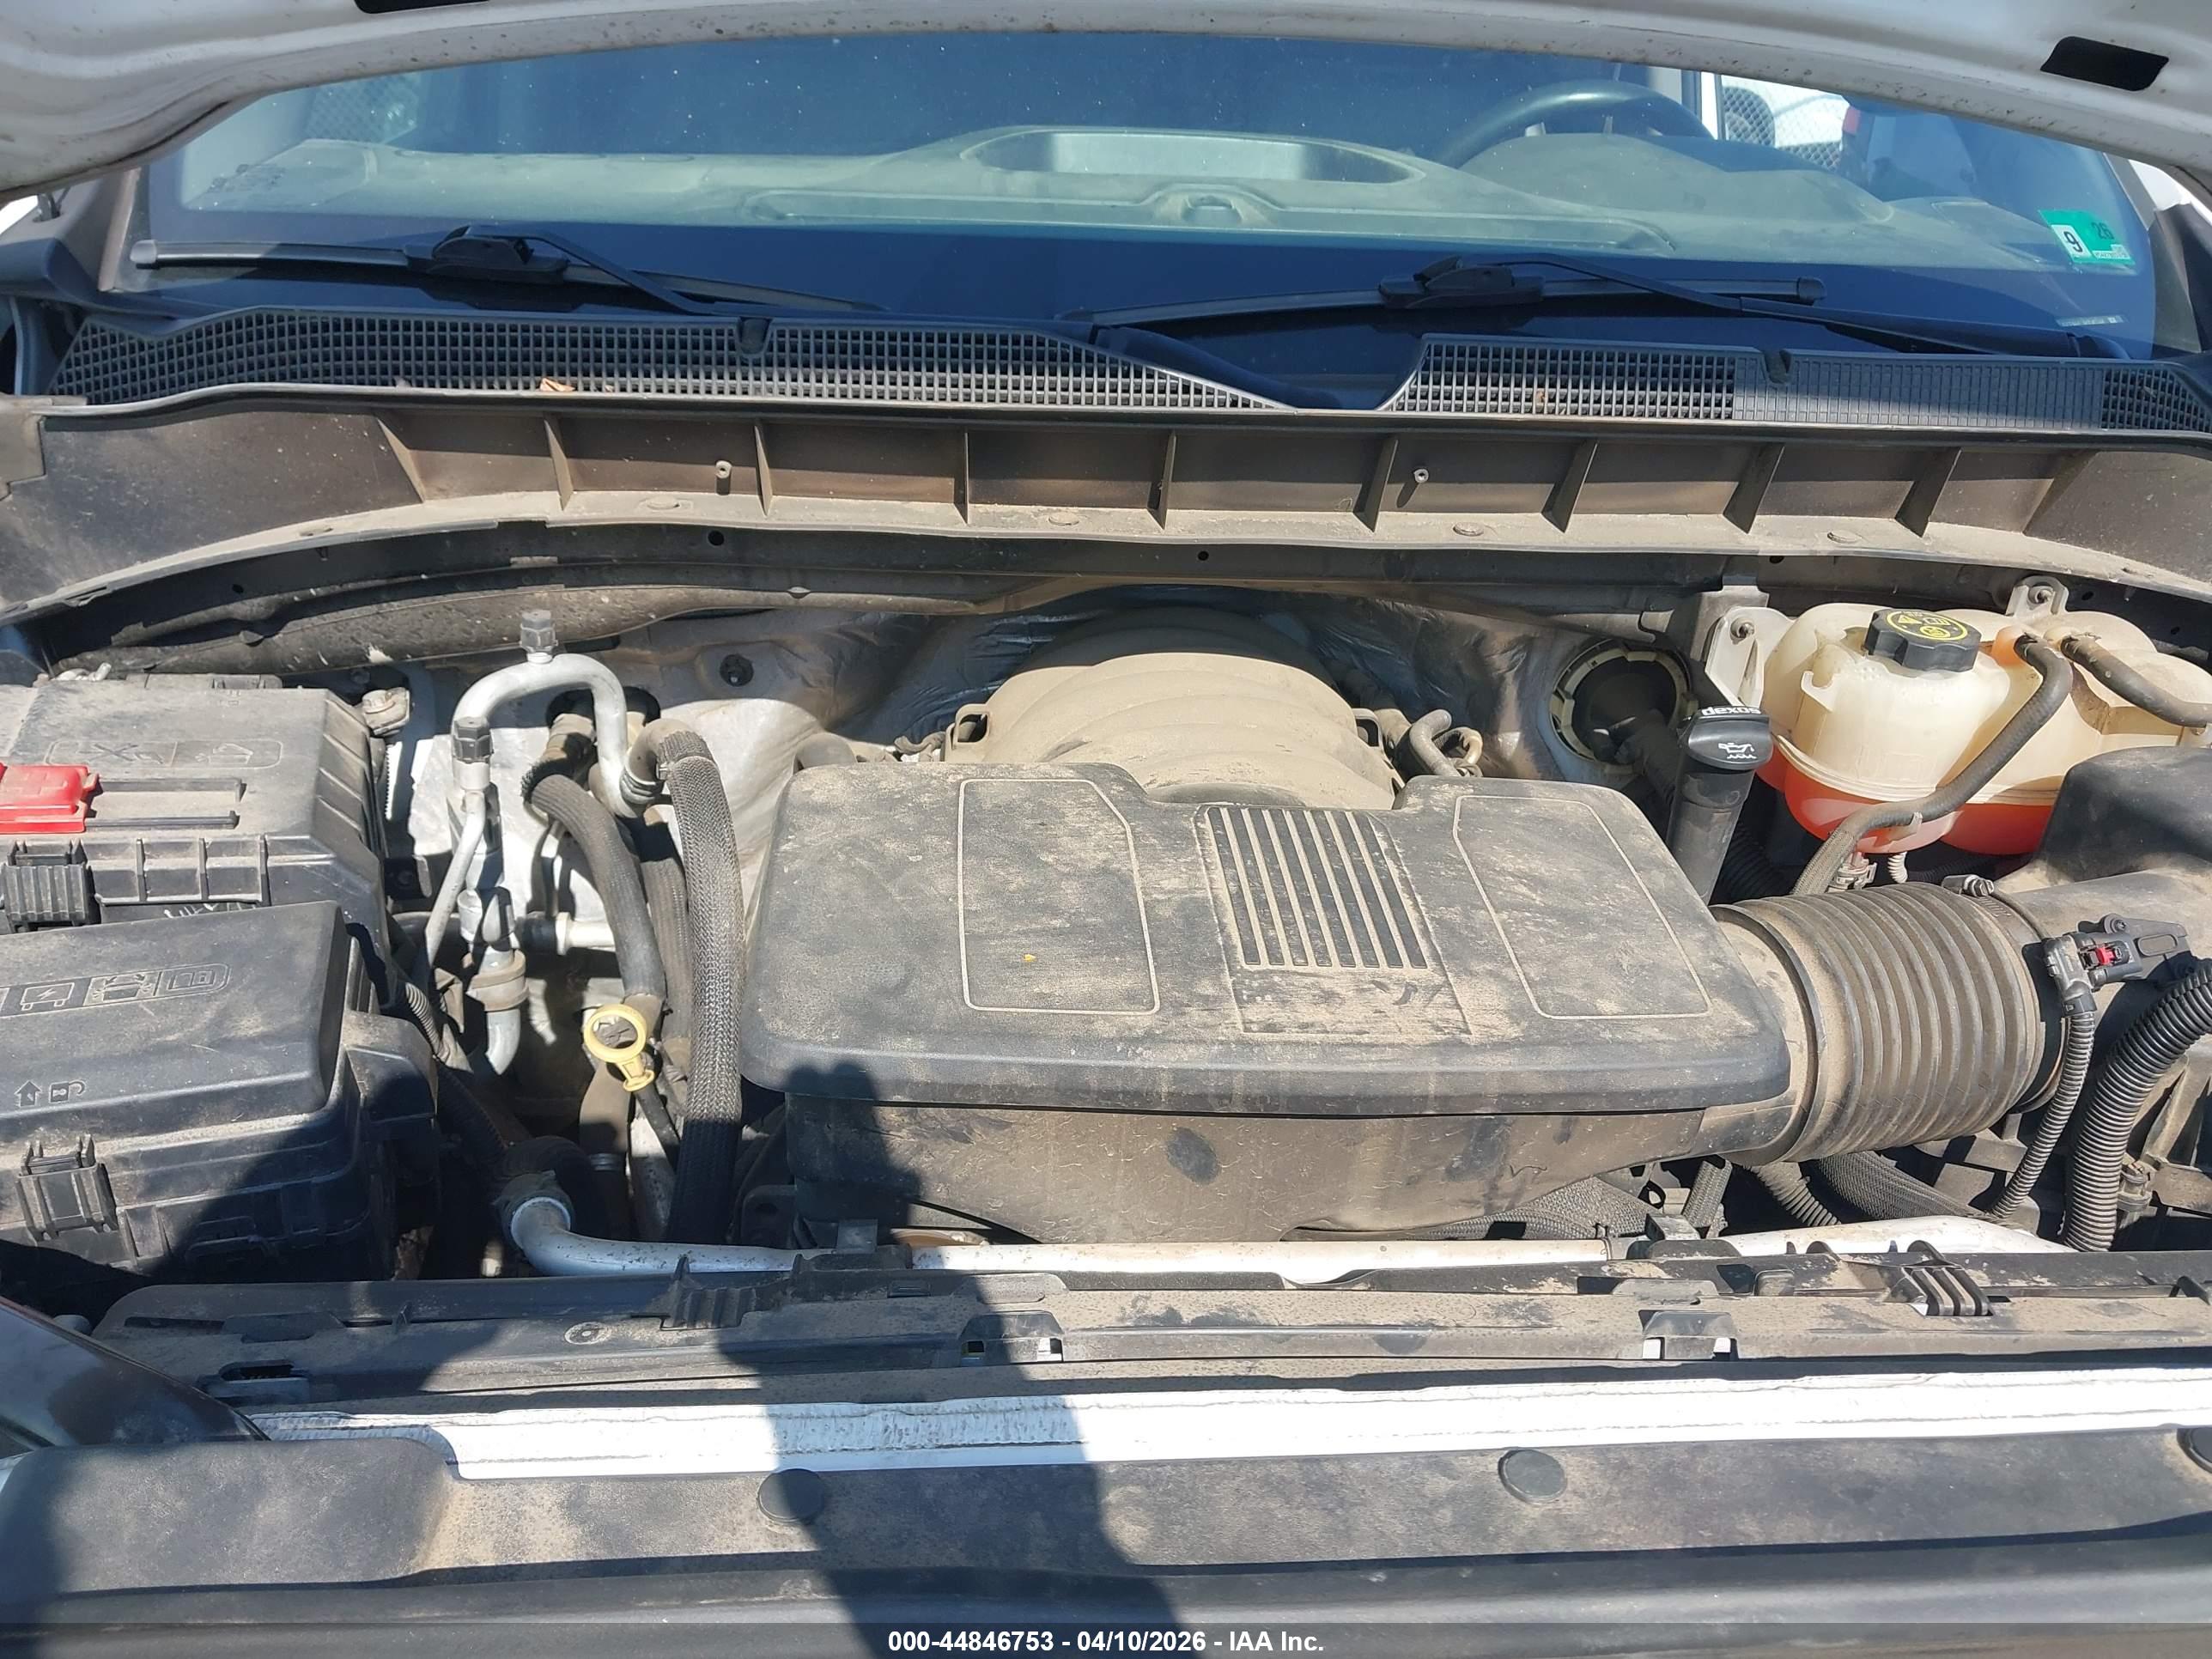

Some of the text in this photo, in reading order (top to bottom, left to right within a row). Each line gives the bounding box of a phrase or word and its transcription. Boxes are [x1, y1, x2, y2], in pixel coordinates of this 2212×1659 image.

[2090, 222, 2115, 240] 26
[2063, 230, 2083, 252] 9
[1701, 707, 1762, 716] dexos
